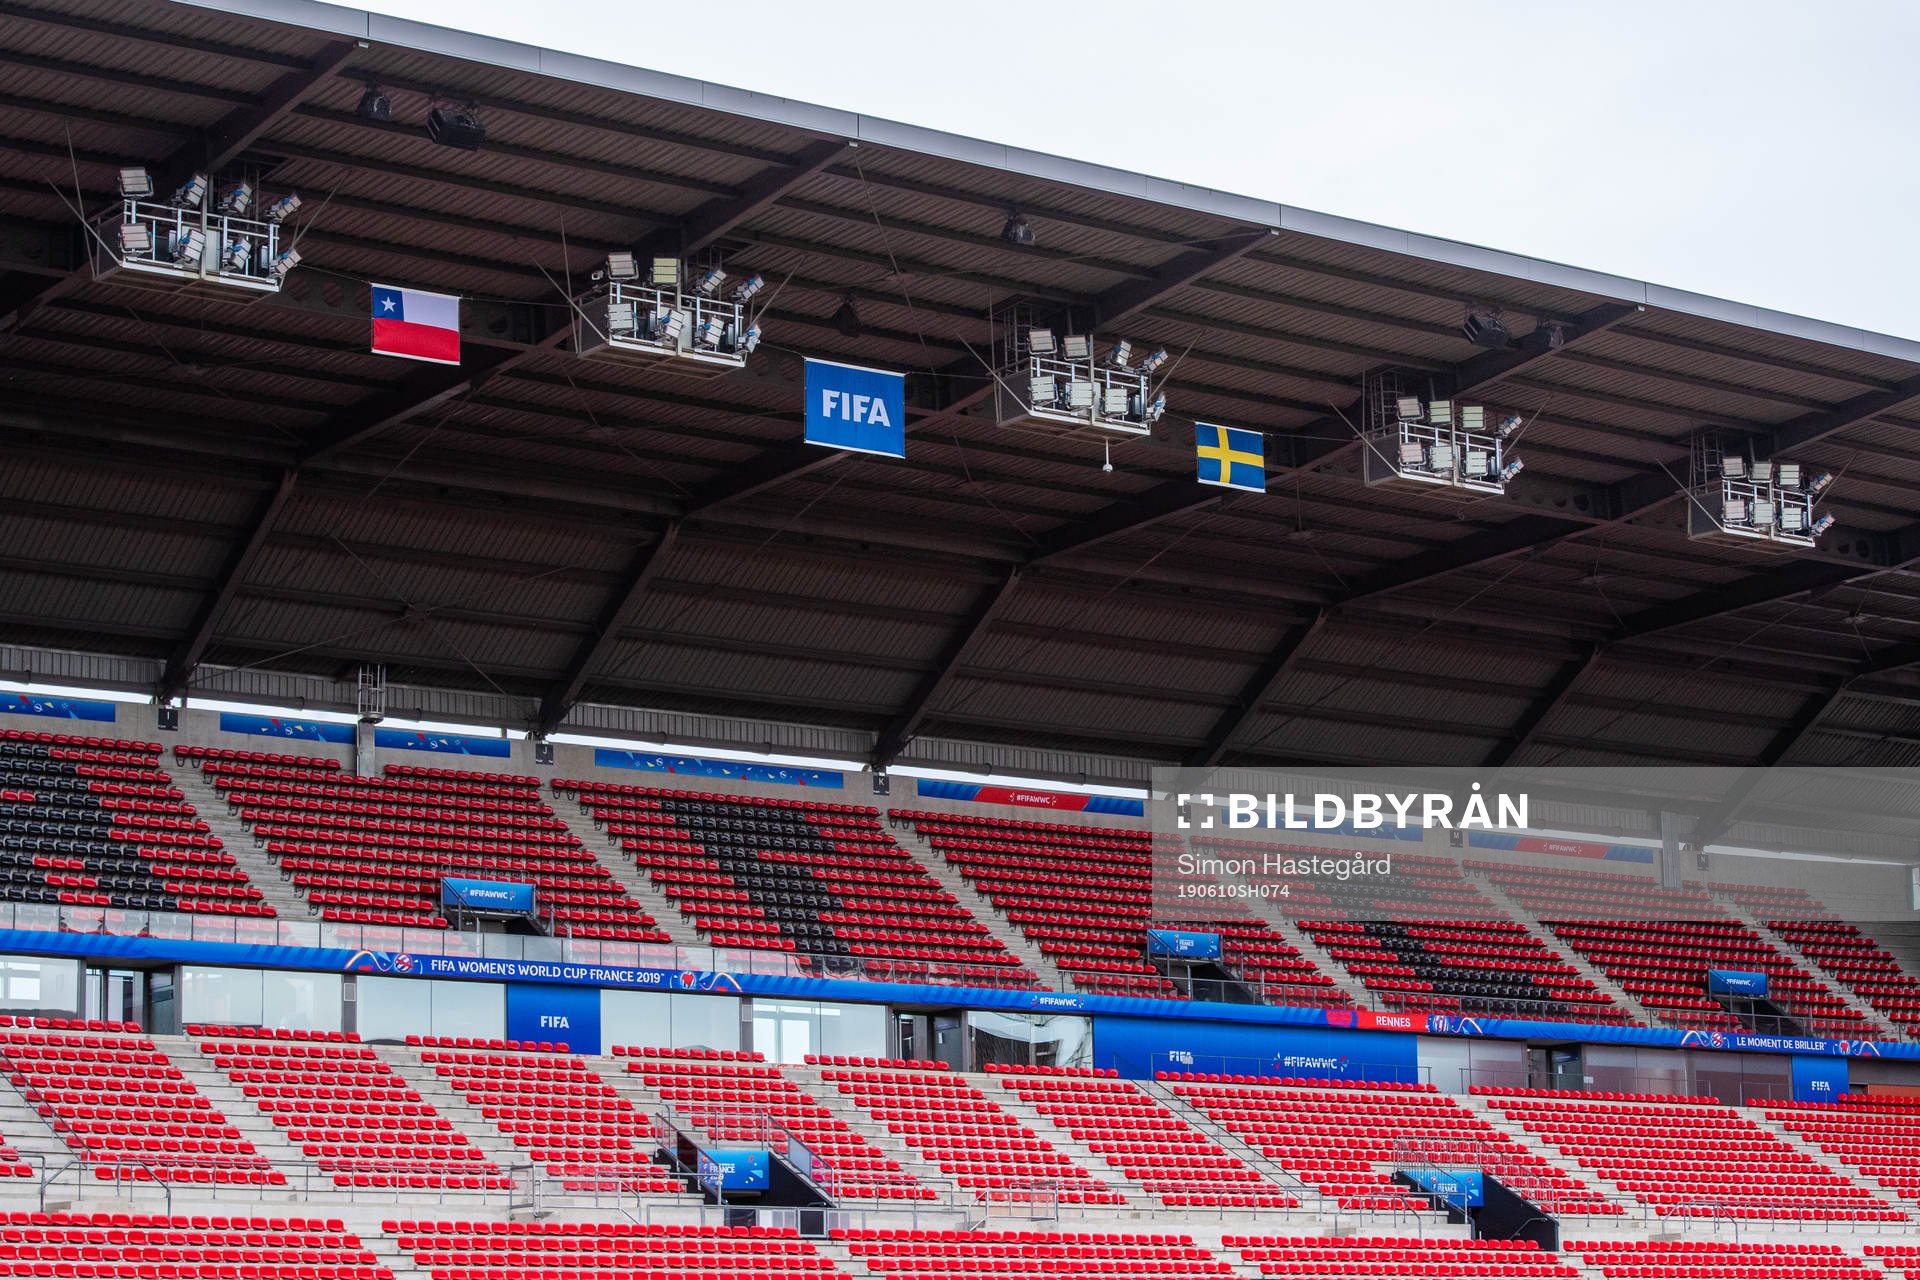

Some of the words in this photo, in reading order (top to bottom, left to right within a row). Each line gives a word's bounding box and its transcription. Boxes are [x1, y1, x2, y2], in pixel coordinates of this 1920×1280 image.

[822, 389, 891, 428] FIFA
[542, 746, 548, 755] J
[878, 777, 885, 786] K
[1016, 794, 1051, 805] #FIFAWWC
[469, 889, 509, 900] #FIFAWWC
[431, 959, 456, 972] FIFA
[458, 961, 516, 976] WOMEN'S
[518, 964, 562, 978] WORLD
[563, 967, 588, 979] CUP
[589, 969, 635, 983] FRANCE
[1039, 997, 1077, 1007] #FIFAWWC
[540, 1015, 570, 1029] FIFA
[1375, 1015, 1412, 1028] RENNES
[1736, 1037, 1747, 1047] LE
[1747, 1038, 1782, 1049] MOMENT
[1783, 1040, 1794, 1049] DE
[1283, 1056, 1338, 1070] #FIFAWWC
[1811, 1081, 1830, 1091] FIFA
